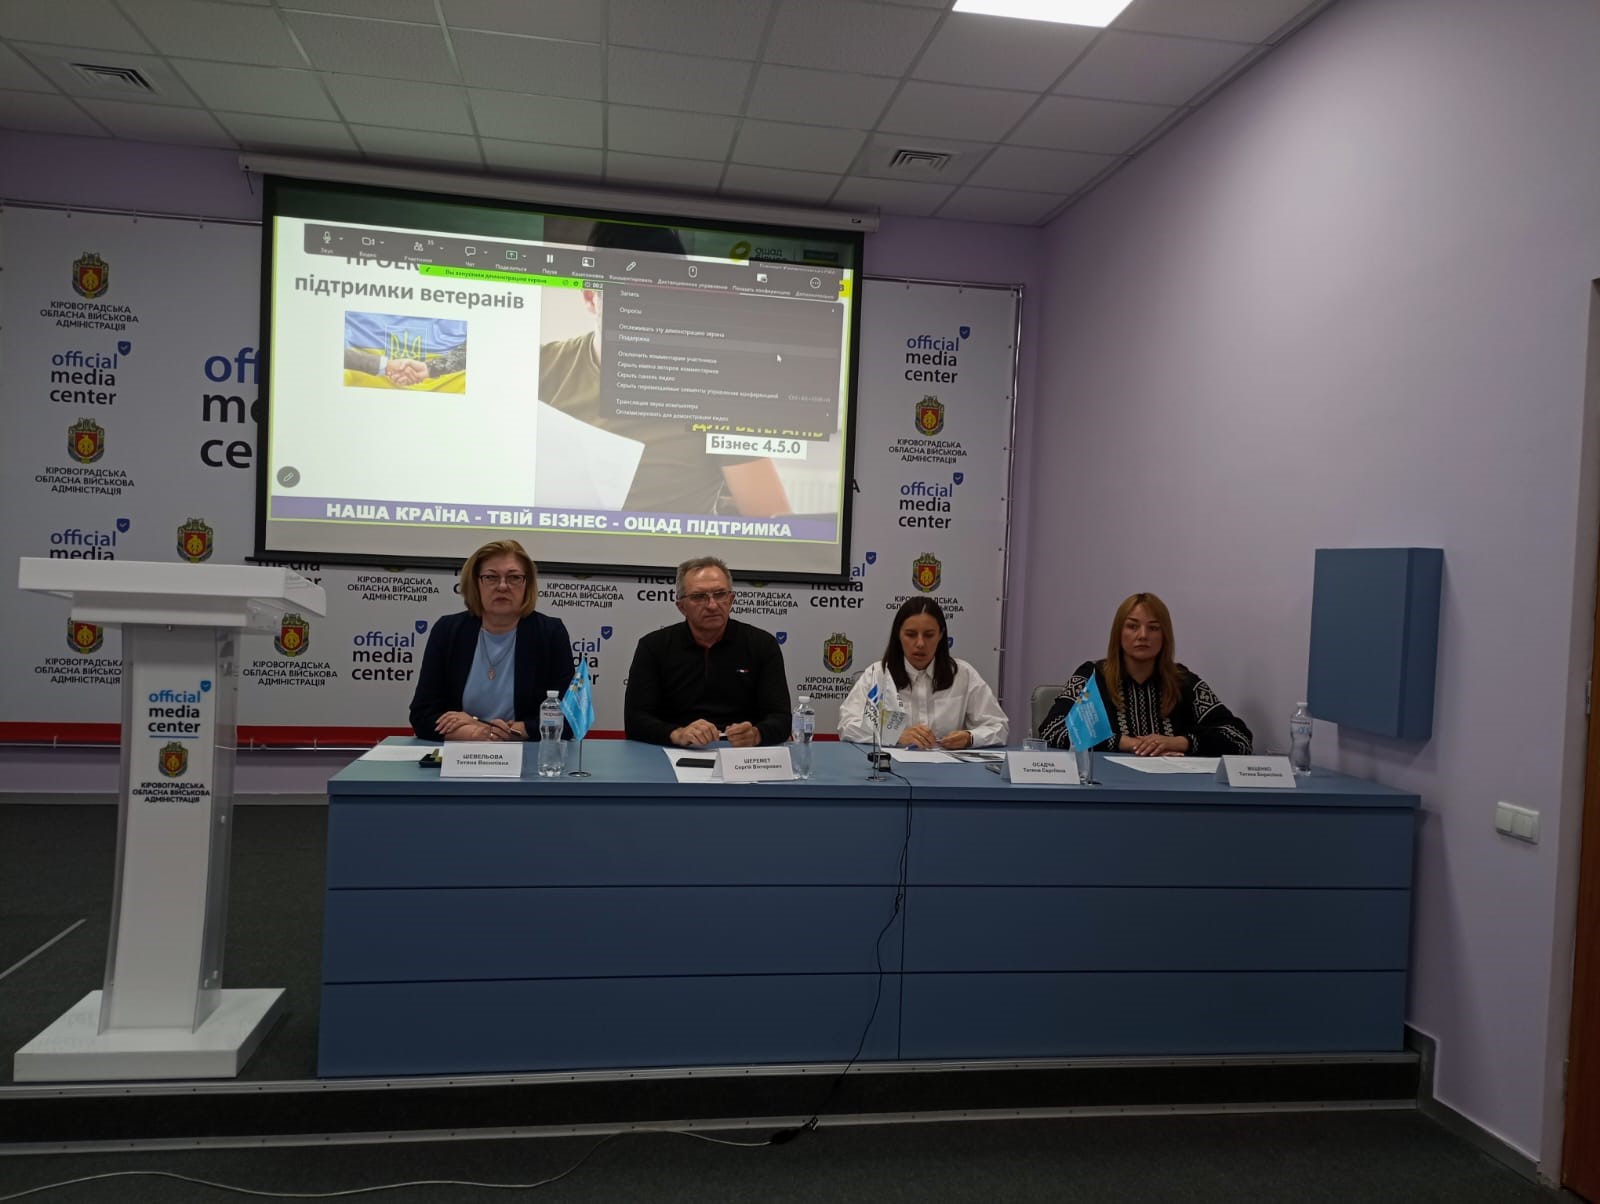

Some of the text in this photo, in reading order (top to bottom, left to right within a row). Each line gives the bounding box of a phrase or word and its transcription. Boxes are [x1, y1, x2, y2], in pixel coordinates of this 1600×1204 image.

[294, 274, 525, 310] підтримки ветеранів
[50, 300, 132, 314] КІРОВОГРАДСЬКА
[40, 309, 139, 323] ОБЛАСНА ВІЙСЬКОВА
[55, 319, 126, 331] АДМІНІСТРАЦІЯ
[906, 334, 959, 351] official
[51, 350, 118, 370] official
[905, 351, 957, 367] media
[50, 368, 116, 387] media
[904, 368, 958, 384] center
[50, 388, 117, 405] center
[711, 435, 801, 454] Бізнес 4.5.0
[897, 438, 962, 449] КІРОВОГРАДСЬКА
[888, 446, 968, 457] ОБЛАСНА ВІЙСЬКОВА
[901, 454, 957, 464] АДМІНІСТРАЦІЯ
[45, 466, 128, 478] КІРОВОГРАДСЬКА
[35, 475, 135, 488] ОБЛАСНА ВІЙСЬКОВА
[51, 485, 122, 496] АДМІНІСТРАЦІЯ
[900, 480, 953, 498] official
[899, 496, 951, 513] media
[326, 502, 390, 520] НАША
[395, 505, 470, 523] КРАЇНА
[486, 509, 533, 526] ТВІЙ
[538, 512, 607, 530] БІЗНЕС
[624, 516, 682, 535] ОЩАД
[686, 519, 792, 537] ПІДТРИМКА
[898, 514, 952, 529] center
[50, 528, 117, 547] official
[356, 575, 433, 586] КІРОВОГРАДСЬКА
[547, 582, 618, 592] КІРОВОГРАДСЬКА
[347, 583, 439, 594] ОБЛАСНА ВІЙСЬКОВА
[361, 592, 428, 602] АДМІНІСТРАЦІЯ
[538, 590, 624, 601] ОБЛАСНА ВІЙСЬКОВА
[810, 595, 864, 609] center
[551, 599, 613, 608] АДМІНІСТРАЦІЯ
[756, 600, 799, 608] ВІЙСЬКОВА
[353, 632, 415, 647] official
[352, 646, 413, 664] media
[35, 666, 81, 676] ОБЛАСНА
[252, 660, 331, 671] КІРОВОГРАДСЬКА
[242, 668, 338, 679] ОБЛАСНА ВІЙСЬКОВА
[351, 665, 414, 681] center
[50, 675, 121, 686] АДМІНІСТРАЦІЯ
[257, 677, 325, 687] АДМІНІСТРАЦІЯ
[149, 690, 201, 704] official
[149, 704, 200, 718] media
[148, 720, 200, 733] center
[140, 782, 205, 790] КІРОВОГРАДСЬКА
[144, 796, 200, 804] АДМІНІСТРАЦІЯ
